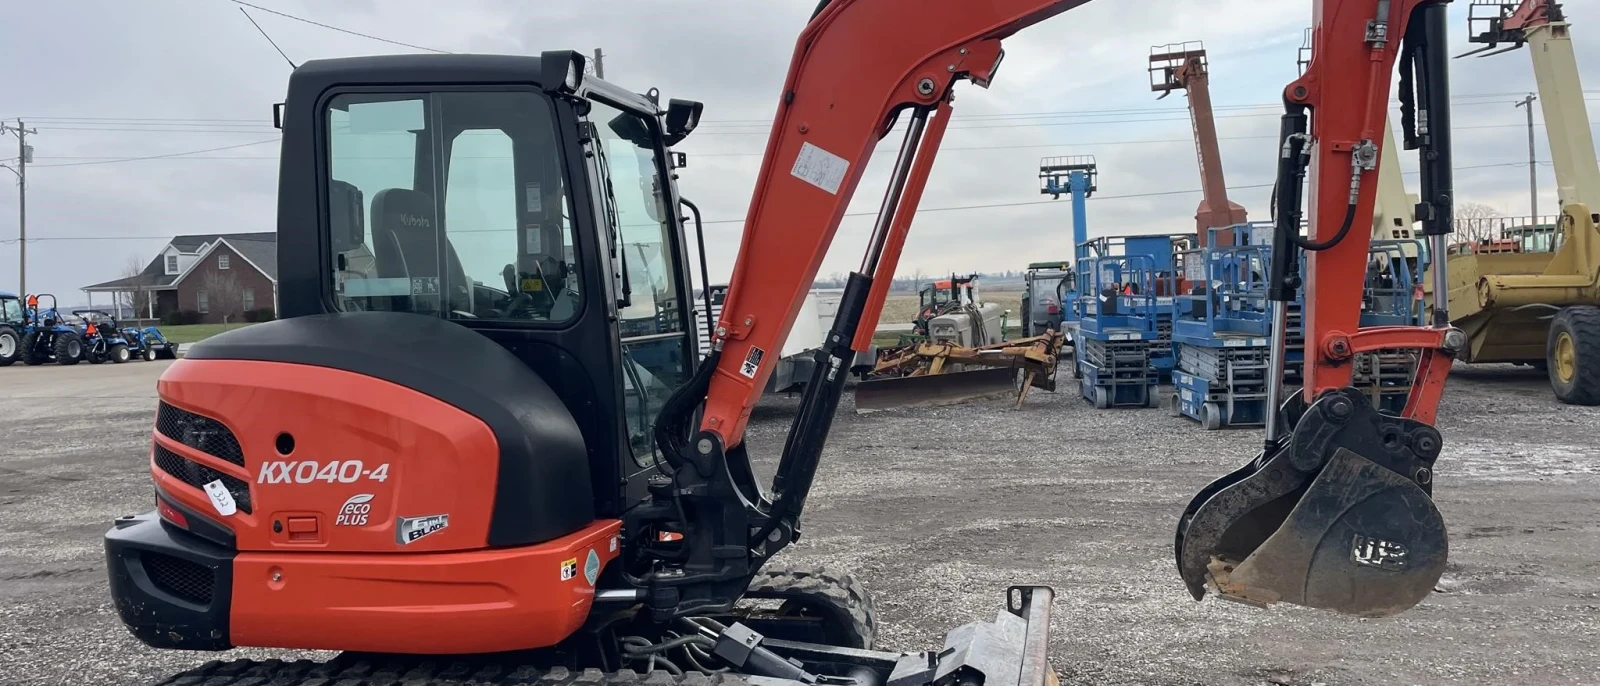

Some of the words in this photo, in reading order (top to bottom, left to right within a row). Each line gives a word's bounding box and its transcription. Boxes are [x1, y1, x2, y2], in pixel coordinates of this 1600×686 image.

[257, 460, 390, 484] KX040-4
[213, 491, 229, 508] 322
[344, 503, 371, 515] eco
[336, 513, 369, 527] PLUS
[409, 522, 446, 541] BLADE
